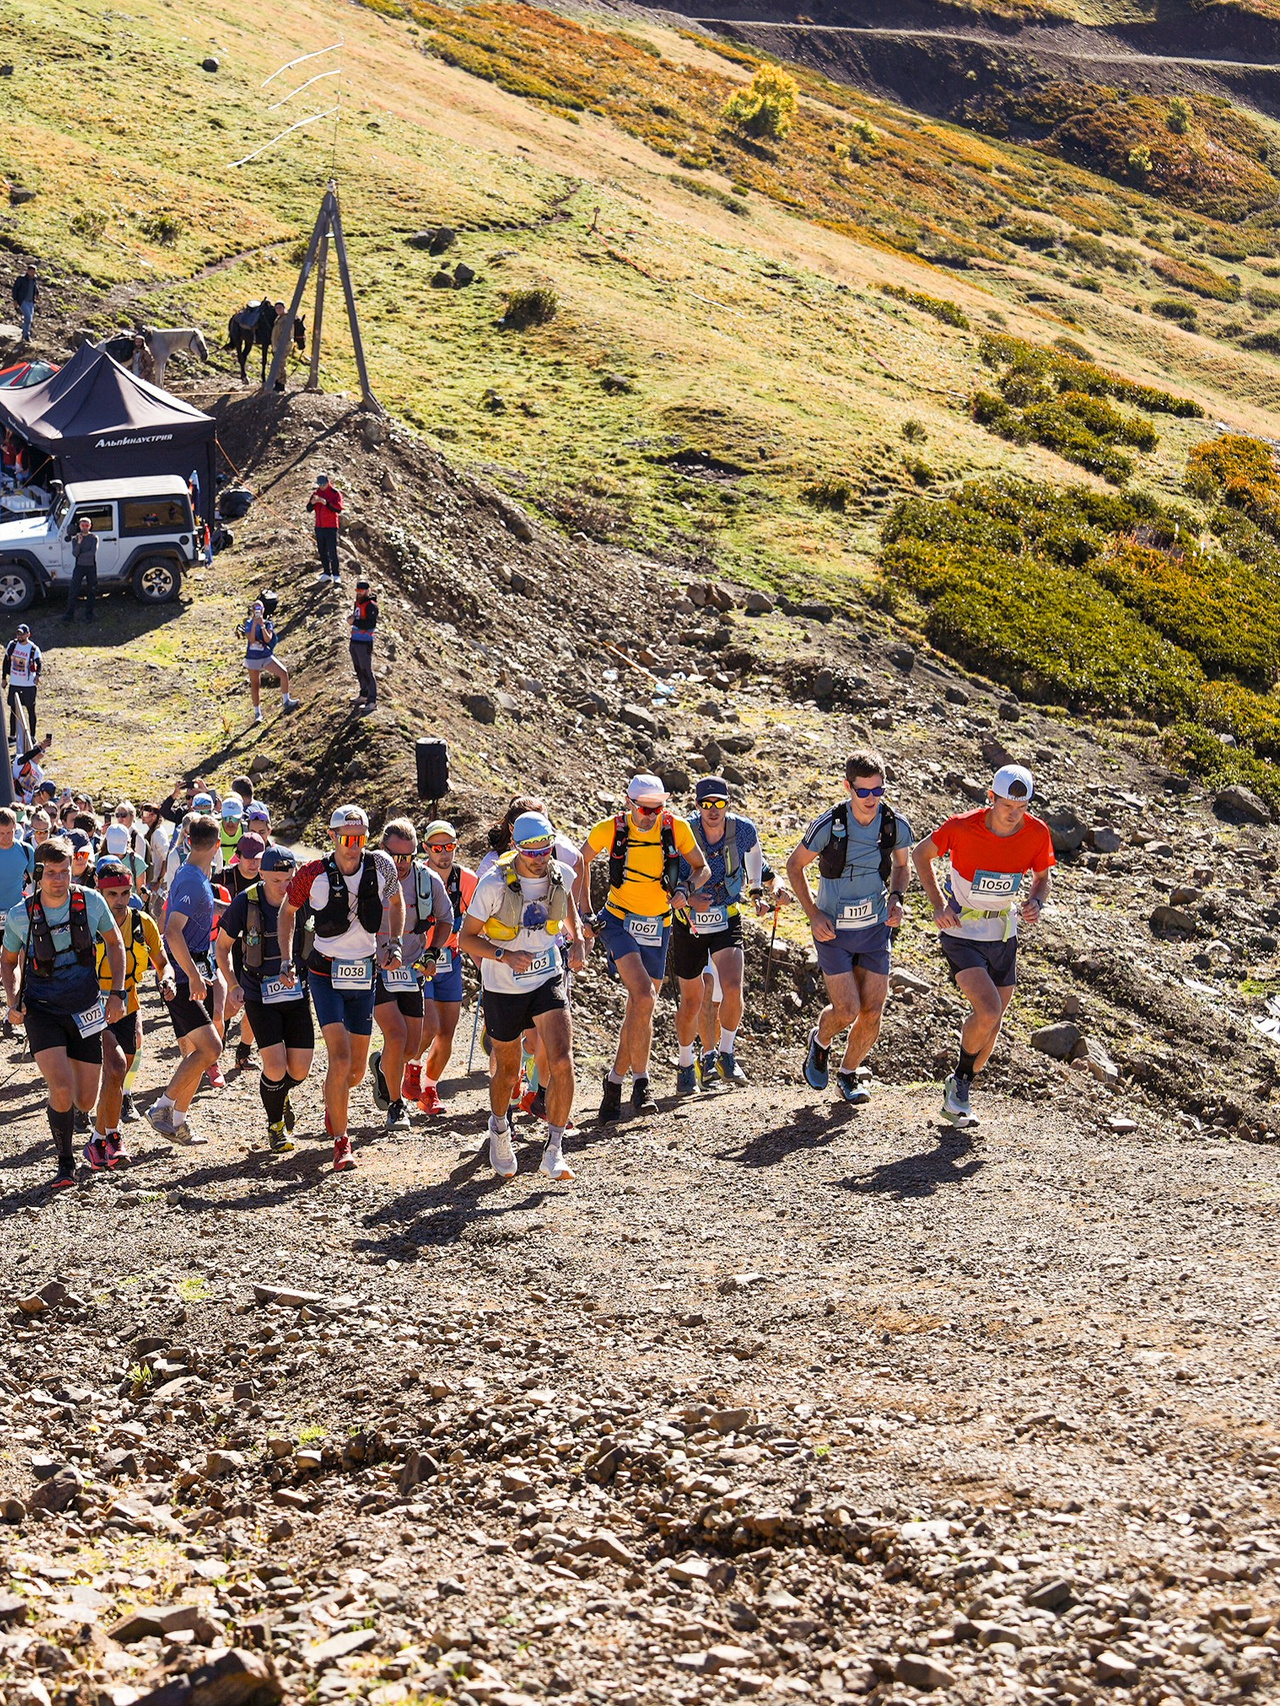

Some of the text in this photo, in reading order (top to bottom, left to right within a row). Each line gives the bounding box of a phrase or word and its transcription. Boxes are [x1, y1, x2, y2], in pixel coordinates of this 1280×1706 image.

[981, 880, 1011, 891] 1050
[849, 905, 868, 917] 1117
[697, 914, 721, 923] 1070
[631, 921, 657, 934] 1067
[525, 957, 547, 971] 103
[340, 966, 365, 976] 1038
[391, 971, 408, 980] 1110
[81, 1008, 102, 1023] 1073
